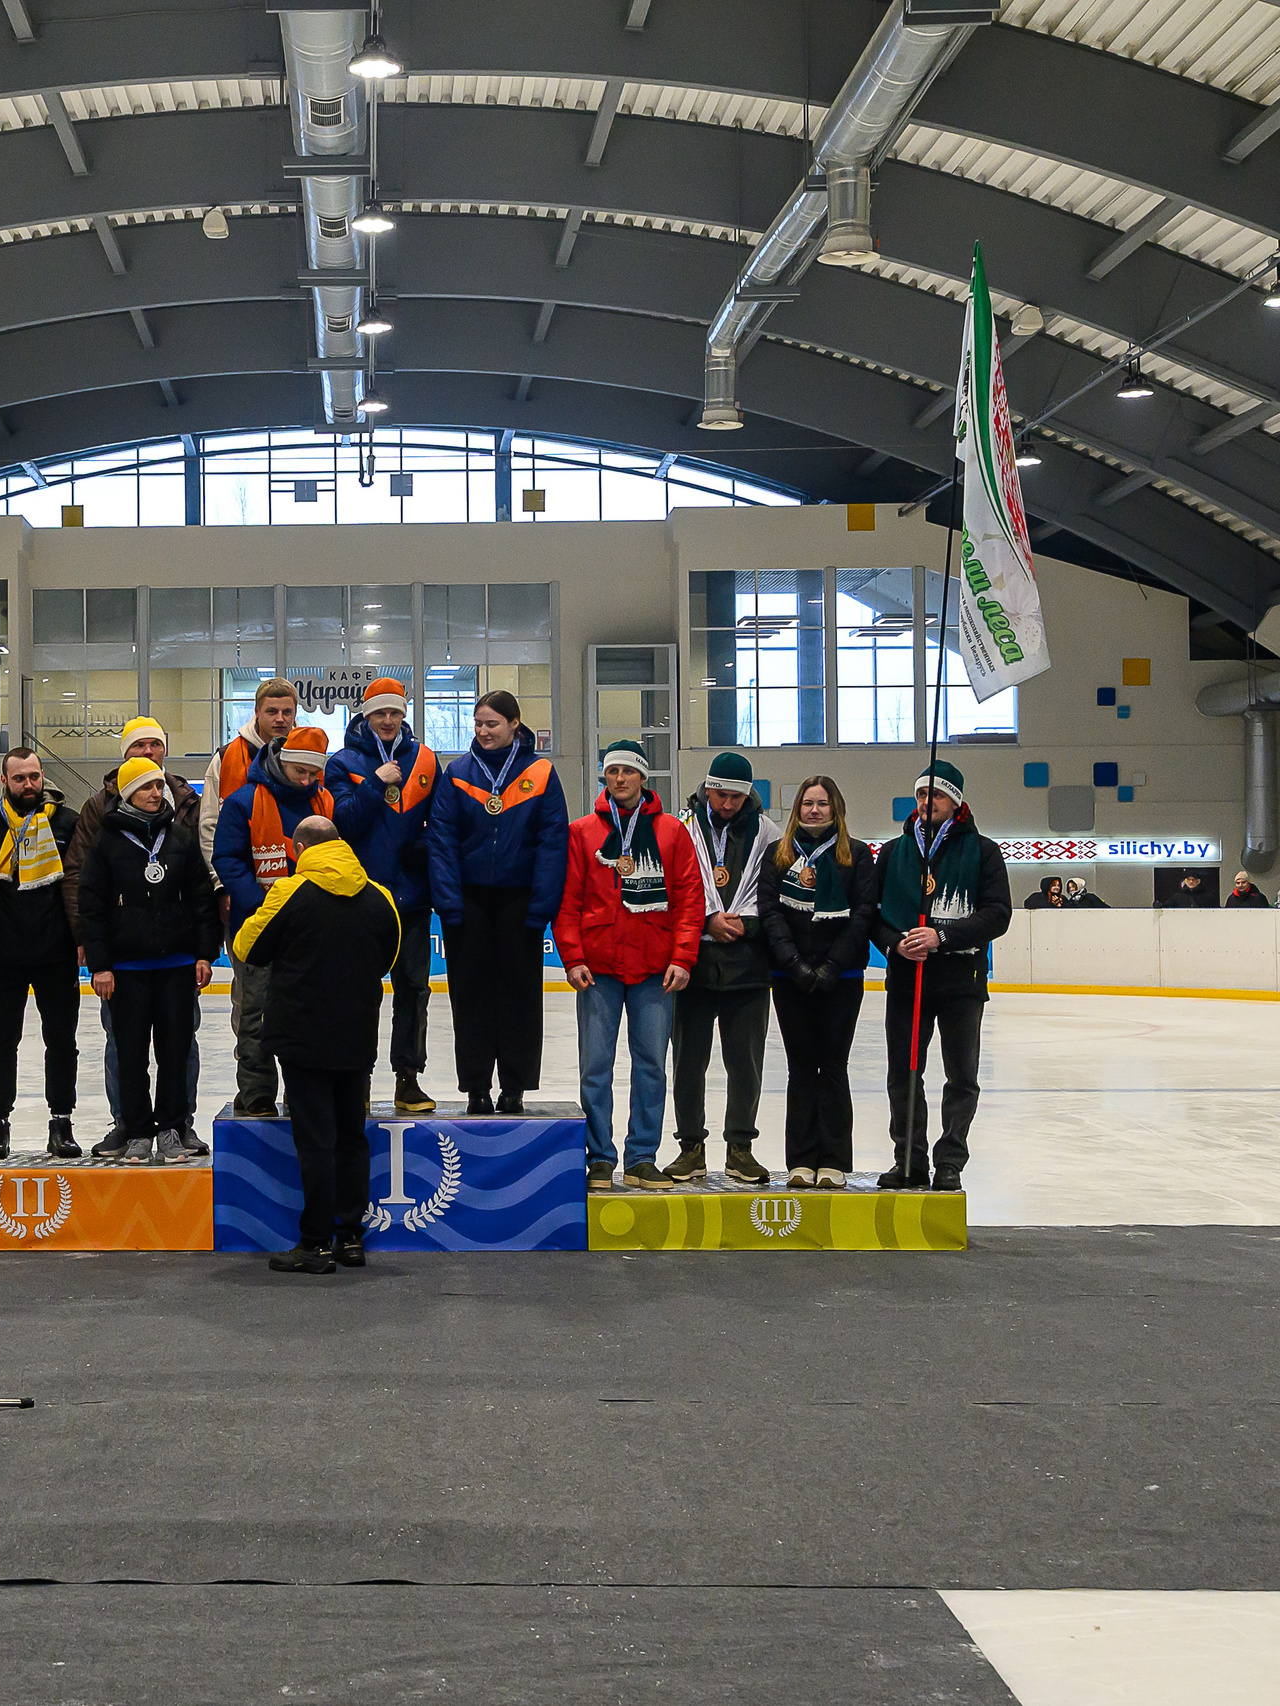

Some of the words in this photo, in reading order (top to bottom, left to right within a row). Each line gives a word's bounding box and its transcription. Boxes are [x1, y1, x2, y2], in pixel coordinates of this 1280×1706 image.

[977, 596, 1025, 667] леса
[329, 671, 372, 681] КАФЕ
[971, 644, 987, 678] Беларусь
[1108, 841, 1210, 858] silichy.by
[378, 1122, 416, 1204] I
[10, 1177, 50, 1217] II
[759, 1199, 794, 1223] III
